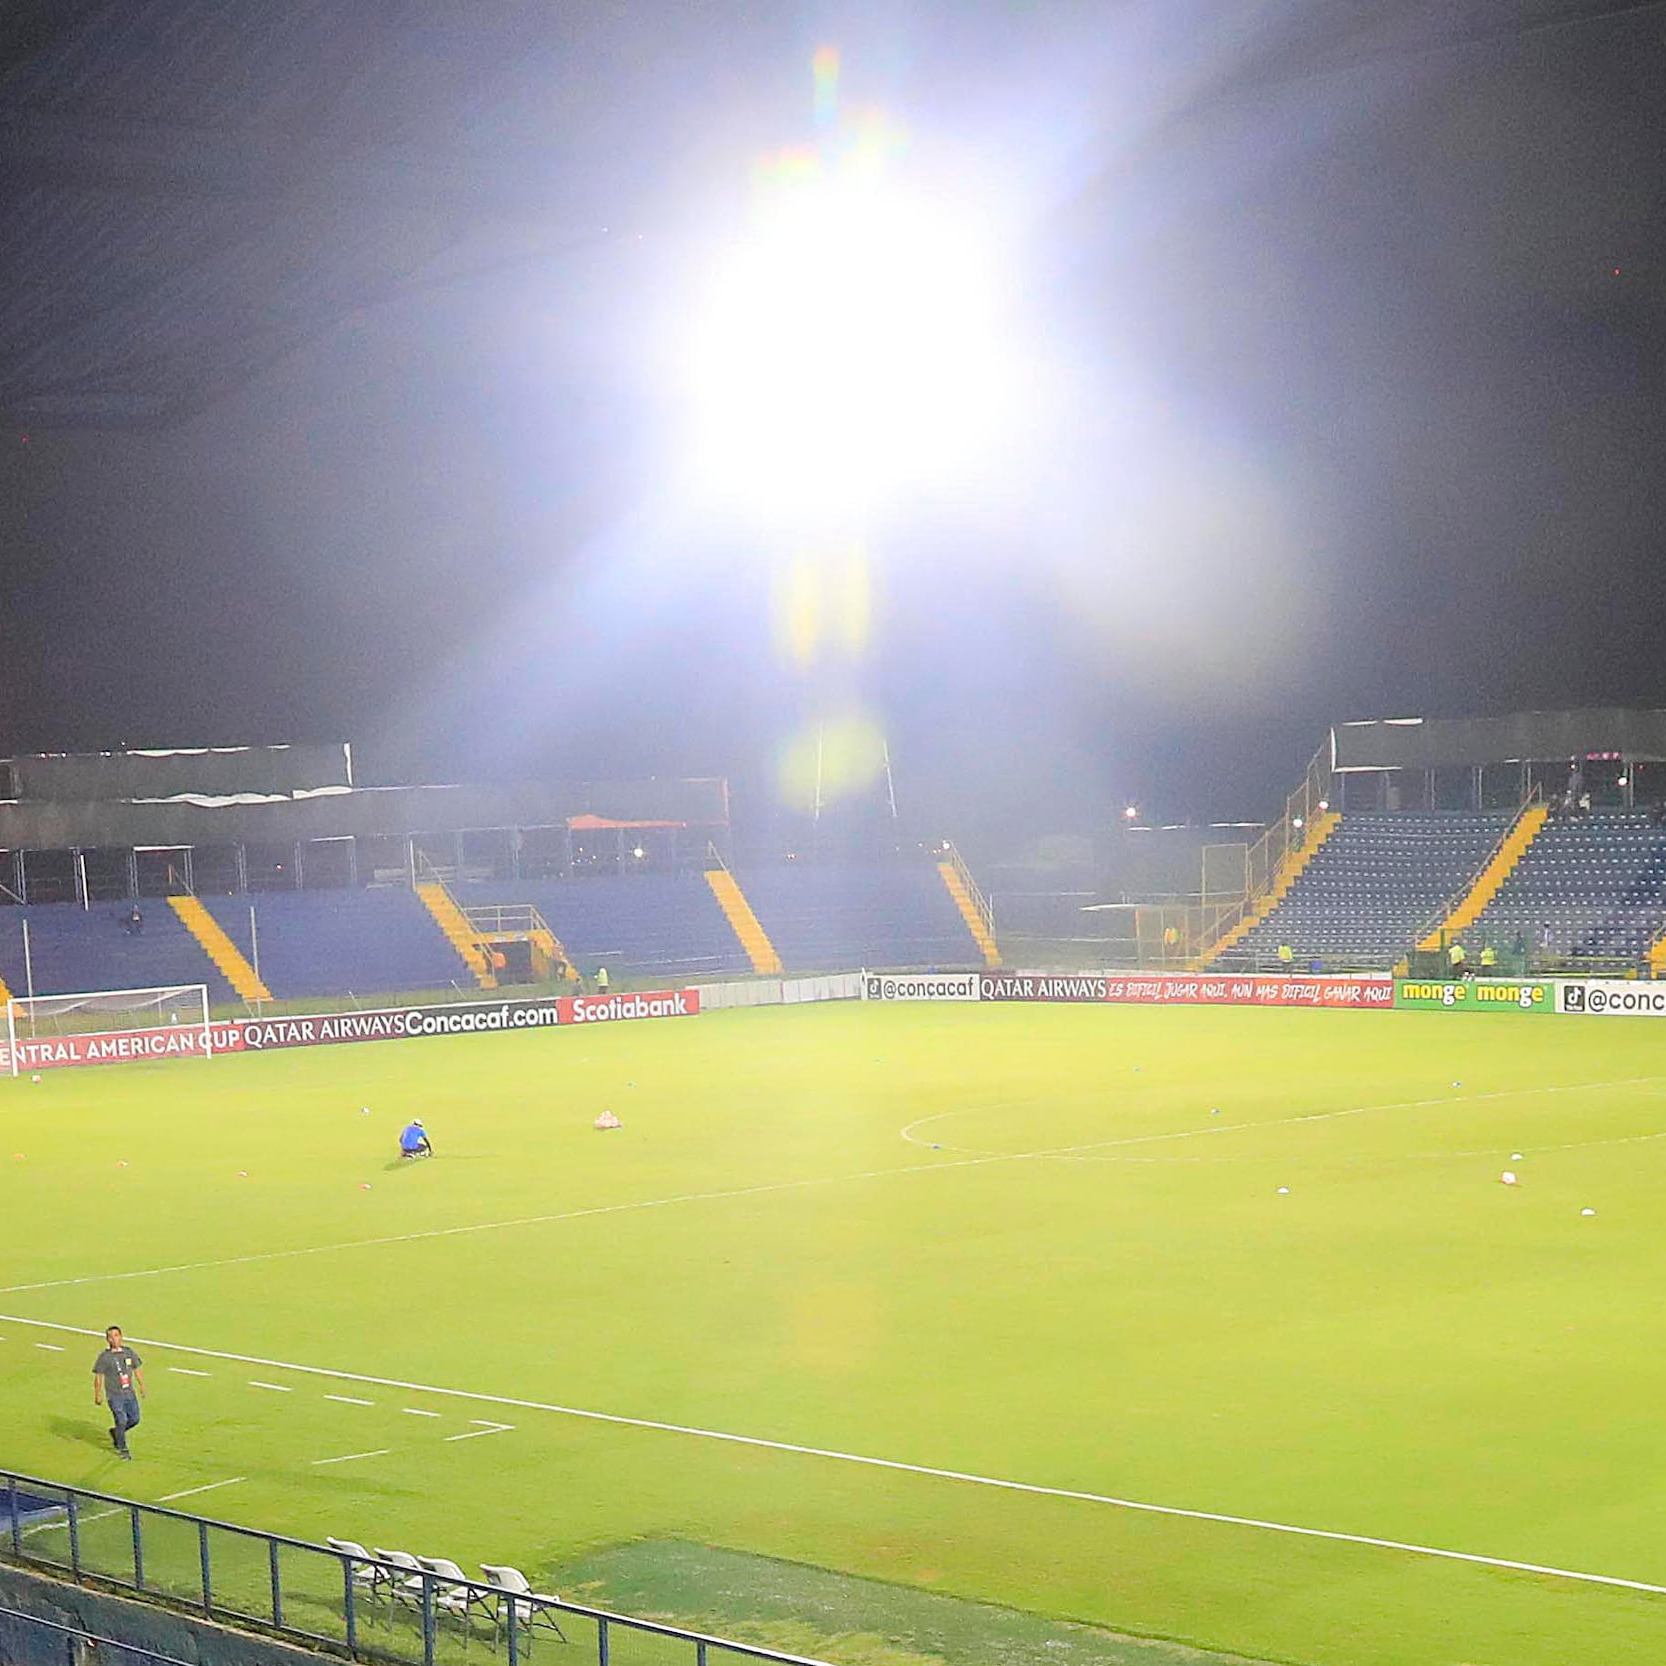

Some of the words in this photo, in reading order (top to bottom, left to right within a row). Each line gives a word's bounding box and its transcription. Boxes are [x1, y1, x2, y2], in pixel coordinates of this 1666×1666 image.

[882, 976, 975, 999] @concacaf
[981, 978, 1034, 999] QATAR
[1037, 979, 1106, 998] AIRWAYS
[1164, 982, 1198, 999] JUGAR
[1402, 983, 1466, 1005] monge
[1476, 984, 1544, 1007] monge
[404, 1005, 558, 1035] Concacaf.com
[572, 993, 687, 1023] Scotiabank
[86, 1031, 195, 1060] AMERICAN
[198, 1026, 241, 1050] CUP
[244, 1021, 316, 1048] QATAR
[319, 1014, 405, 1040] AIRWAYS
